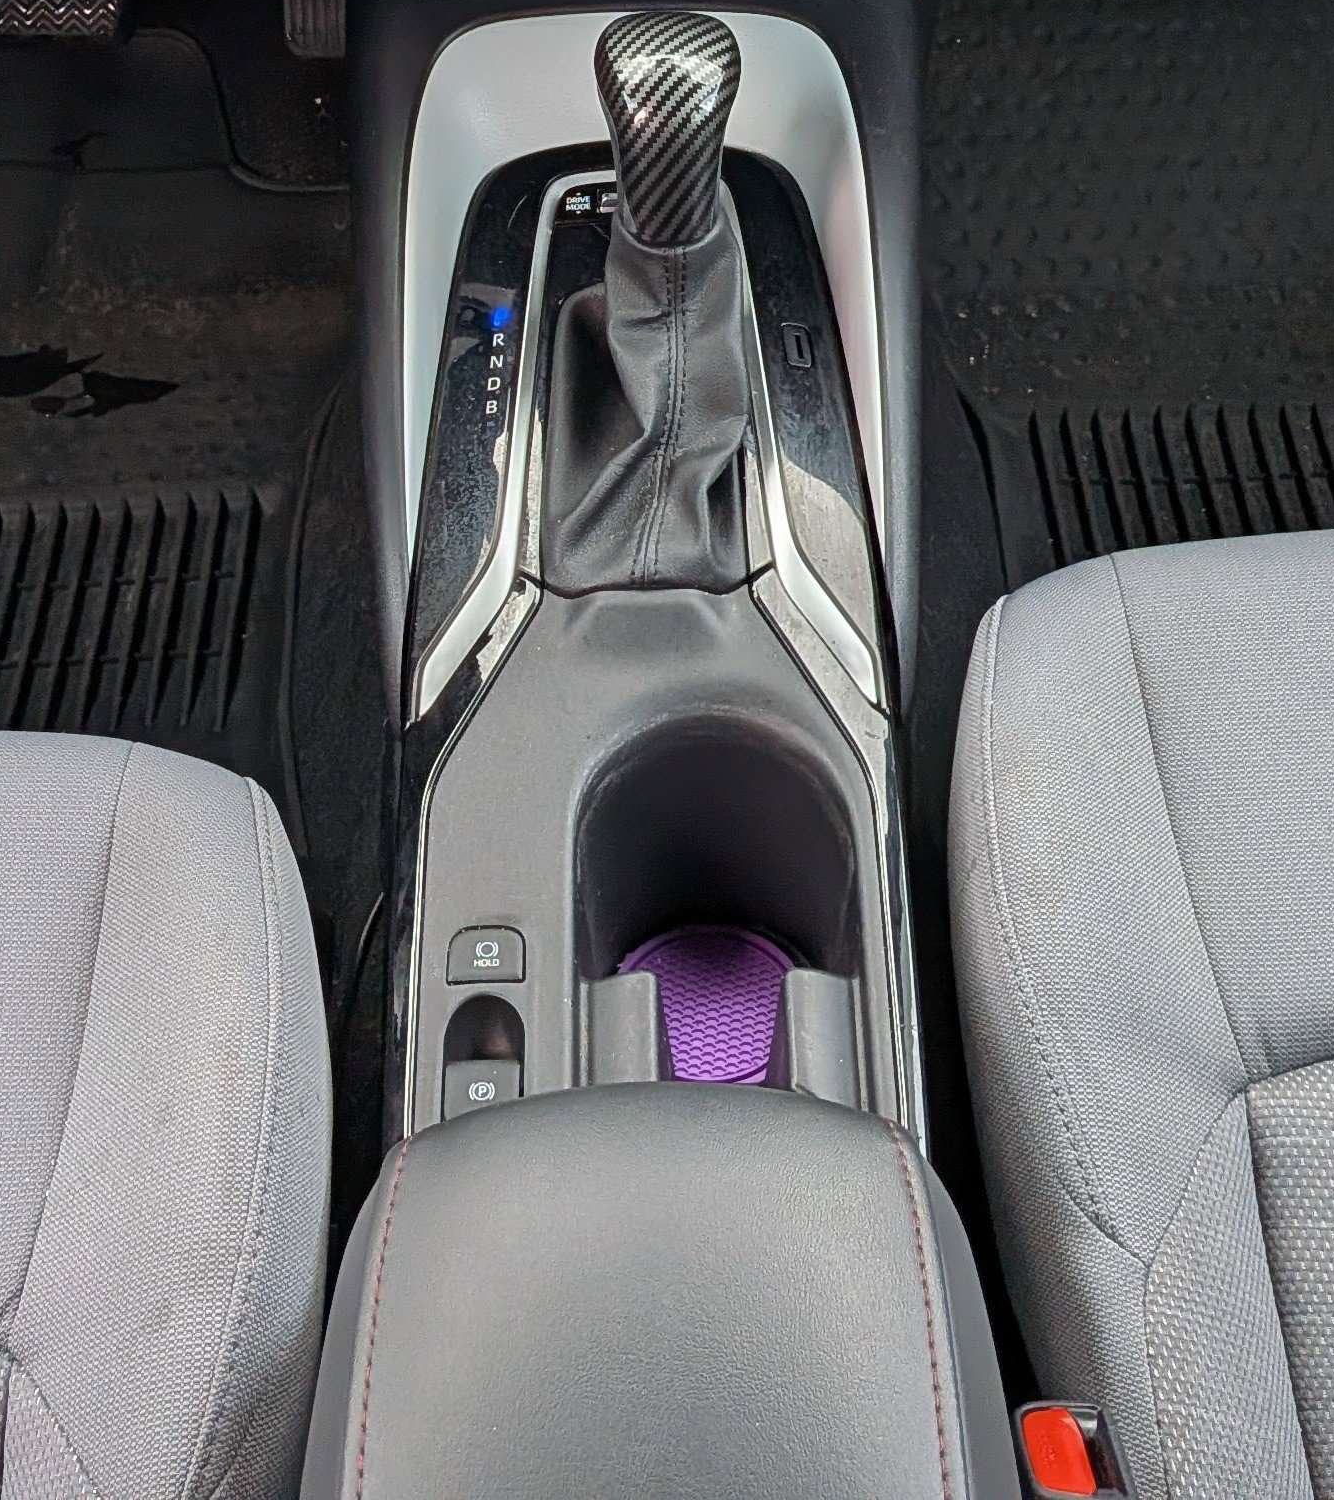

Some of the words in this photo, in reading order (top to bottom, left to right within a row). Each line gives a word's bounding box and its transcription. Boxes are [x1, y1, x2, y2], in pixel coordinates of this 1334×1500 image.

[565, 203, 591, 212] MODE
[493, 308, 508, 327] P
[493, 334, 505, 346] R
[489, 355, 503, 368] N
[487, 377, 501, 390] D
[485, 400, 498, 414] B
[473, 958, 499, 967] HOLD
